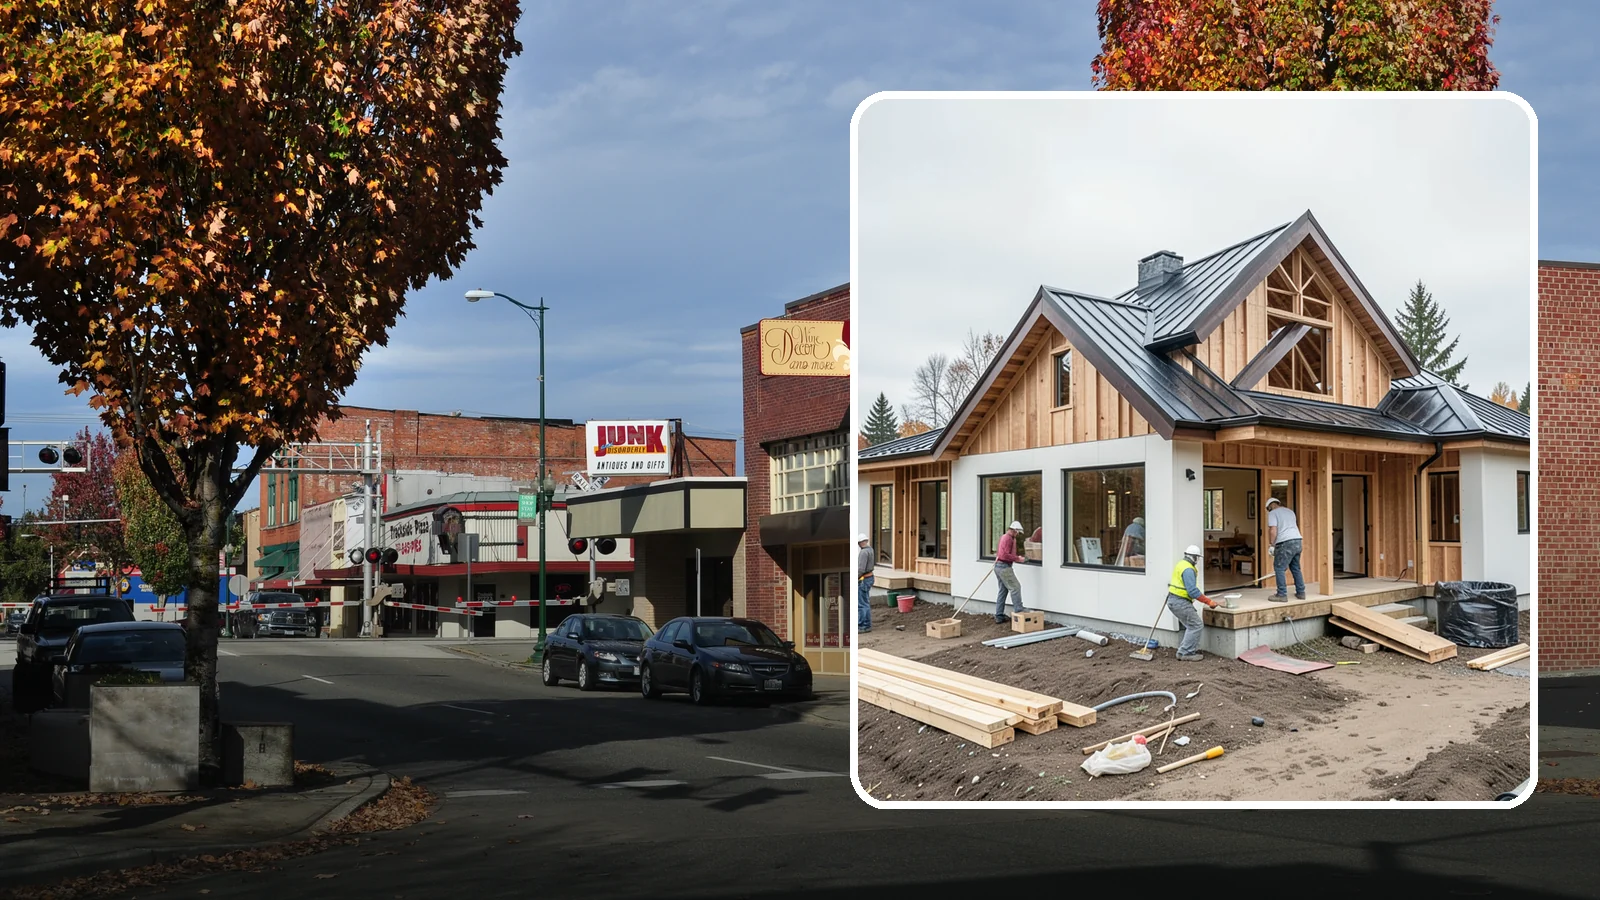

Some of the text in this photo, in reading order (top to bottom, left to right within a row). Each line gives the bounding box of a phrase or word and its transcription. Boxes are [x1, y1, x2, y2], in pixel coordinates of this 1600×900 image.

[595, 426, 665, 457] JUNK
[597, 460, 666, 470] ANTIQUES AND GIFTS
[588, 476, 607, 491] SING
[414, 519, 429, 535] Pizza
